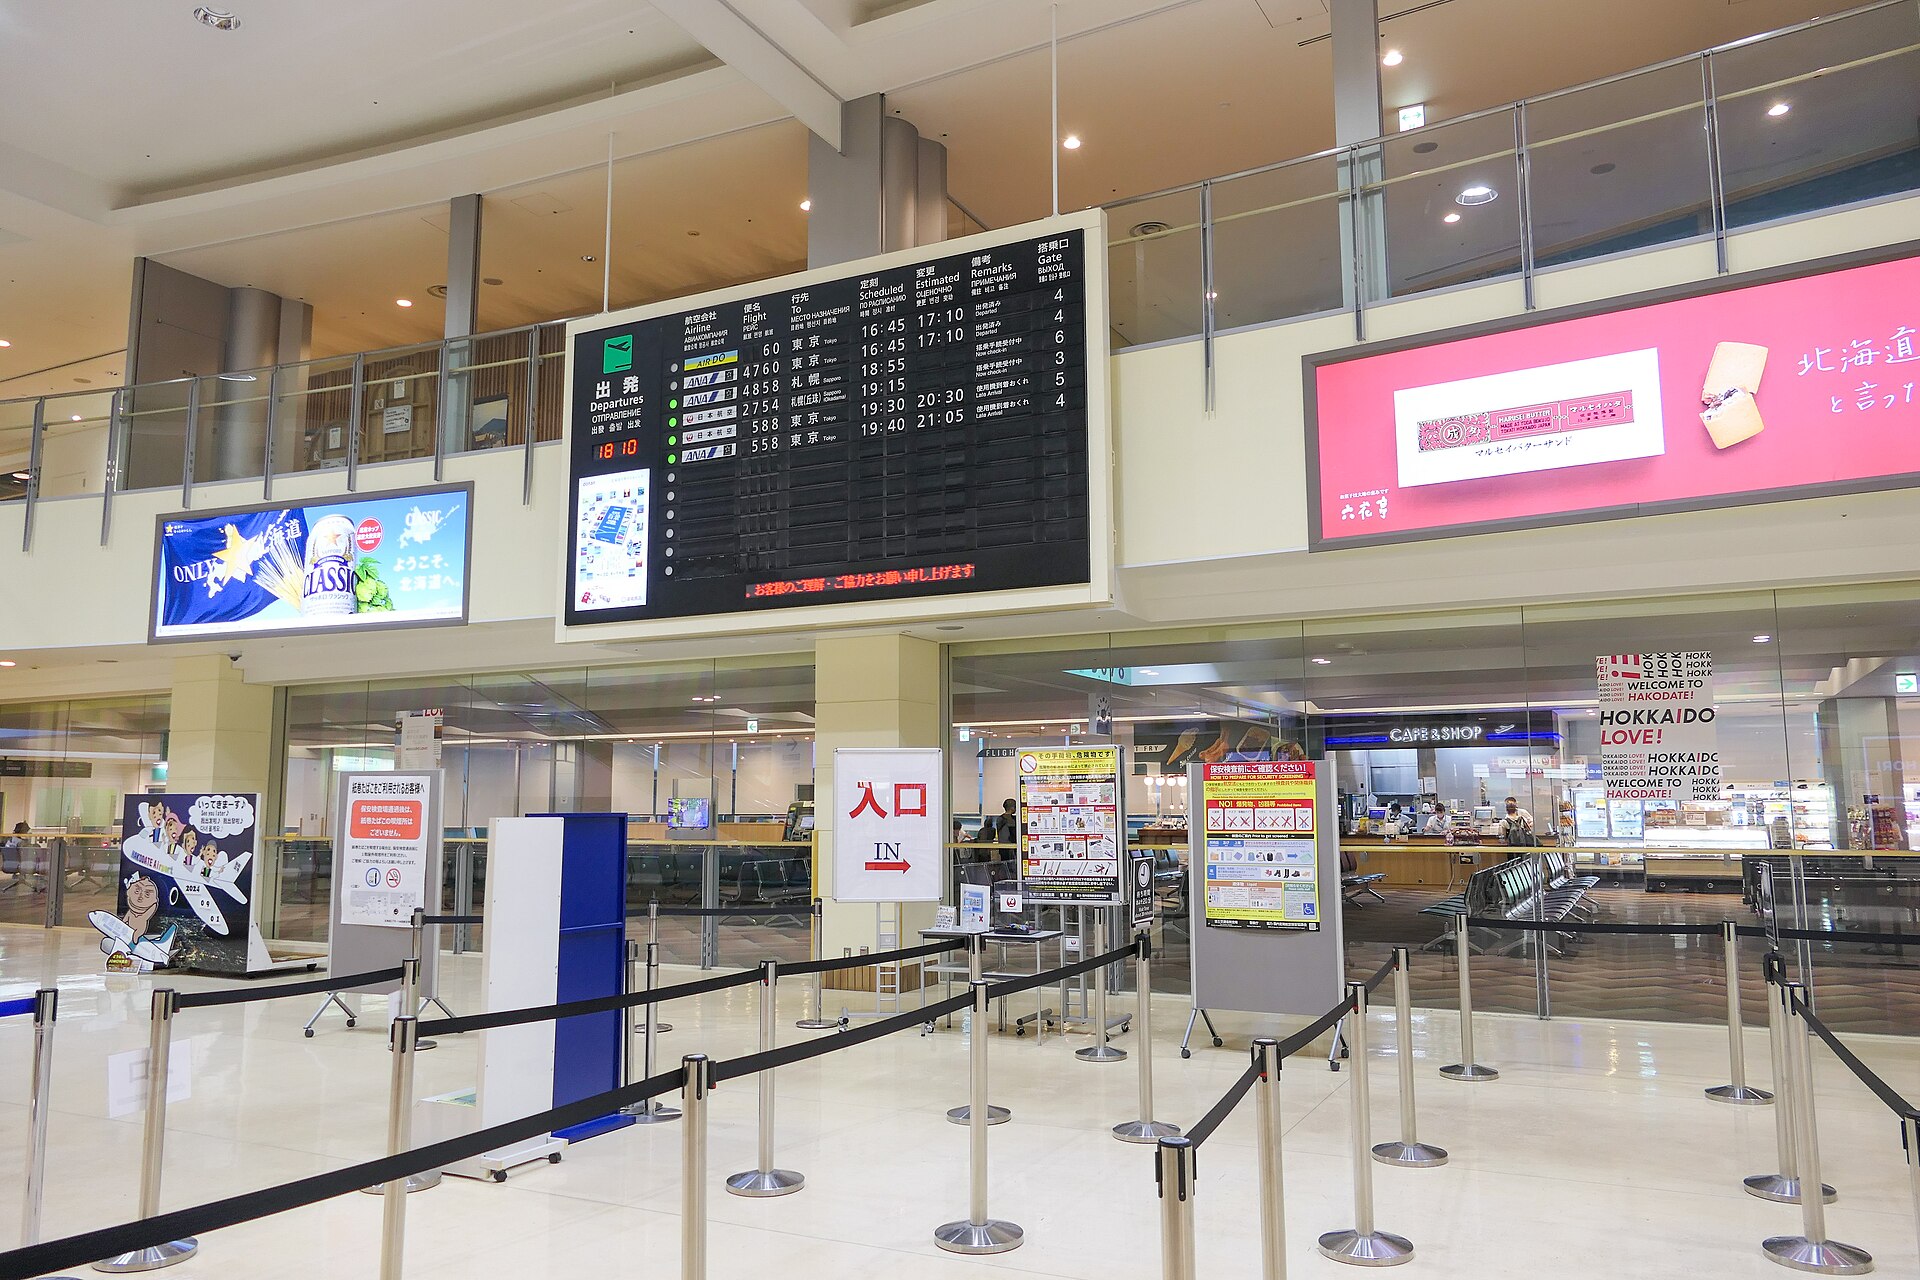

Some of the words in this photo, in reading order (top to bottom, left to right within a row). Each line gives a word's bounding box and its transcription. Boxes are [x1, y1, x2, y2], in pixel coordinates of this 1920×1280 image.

[1038, 238, 1069, 254] 搭乗口
[971, 253, 992, 267] 備考
[1037, 253, 1063, 265] Gate
[916, 265, 936, 278] 変更
[971, 262, 1013, 279] Remarks
[1037, 263, 1065, 275] ВЫХОД
[860, 277, 879, 290] 定刻
[915, 271, 960, 290] Estimated
[970, 272, 1017, 288] ПРИМЕЧАНИЯ
[791, 292, 810, 304] 行先
[859, 283, 904, 301] Scheduled
[915, 285, 953, 299] ОЦЕНОЧНО
[743, 302, 761, 314] 便名
[791, 305, 802, 315] To
[859, 301, 869, 310] ПО
[868, 294, 907, 308] РАСПИСАНИЮ
[684, 310, 717, 326] 航空会社
[743, 312, 767, 325] Flight
[790, 313, 811, 323] МЕСТО
[811, 305, 851, 319] НАЗНАЧЕНИЯ
[975, 307, 998, 317] Departed
[684, 323, 711, 336] Airline
[696, 356, 711, 368] AIR
[712, 352, 726, 364] DO
[762, 341, 780, 357] 60
[791, 334, 821, 351] 東京
[861, 318, 906, 338] 16:45
[917, 307, 964, 328] 17:10
[1054, 287, 1064, 302] 4
[743, 323, 759, 333] РЕЙС
[975, 328, 998, 337] Departed
[683, 329, 728, 344] АВИАКОМПАНИЯ
[686, 377, 709, 389] ANA
[742, 361, 780, 379] 4760
[791, 353, 821, 371] 東京
[861, 337, 906, 358] 16:45
[917, 327, 964, 349] 17:10
[1054, 308, 1064, 323] 4
[1797, 325, 1920, 376] 北海道
[686, 395, 709, 407] ANA
[742, 379, 780, 398] 4858
[791, 373, 820, 389] 札幌
[822, 375, 842, 384] Sapporo
[861, 357, 906, 378] 18:55
[1054, 329, 1065, 344] 6
[697, 408, 733, 421] 日本航空
[742, 398, 780, 417] 2754
[823, 388, 842, 397] Sapporo
[861, 377, 906, 398] 19:15
[1055, 351, 1065, 365] 3
[590, 395, 645, 413] Departures
[697, 427, 733, 440] 日本航空
[751, 417, 779, 434] 588
[790, 411, 820, 429] 東京
[822, 414, 837, 422] Tokyo
[861, 397, 906, 417] 19:30
[916, 388, 964, 409] 20:30
[1055, 371, 1065, 386] 5
[591, 407, 643, 424] ОТПРАВЛЕНИЕ
[1525, 409, 1551, 419] BUTTER
[685, 449, 708, 462] ANA
[751, 436, 779, 453] 558
[790, 431, 820, 447] 東京
[822, 434, 837, 442] Tokyo
[861, 417, 906, 437] 19:40
[916, 408, 964, 429] 21:05
[1055, 393, 1066, 408] 4
[599, 442, 615, 459] 18
[622, 438, 638, 456] 10
[1475, 435, 1573, 457] マルセイバターサンド
[1340, 495, 1388, 520] 六花亭
[173, 558, 218, 583] ONLY
[303, 566, 357, 599] CLASSIC
[1685, 651, 1712, 660] HOKK
[1686, 660, 1712, 669] HOKK
[1686, 669, 1713, 678] HOKK
[1627, 680, 1685, 691] WELCOME
[1687, 679, 1704, 688] TO
[1628, 690, 1694, 702] HAKODATE!
[1600, 707, 1716, 726] HOKKAIDO
[1389, 727, 1428, 743] CAFE
[1429, 728, 1441, 741] &
[1440, 726, 1482, 741] SHOP
[1600, 728, 1663, 745] LOVE!
[1209, 763, 1307, 774] 保安検査前にご確認ください!
[1606, 779, 1663, 788] WELCOME
[1666, 778, 1682, 788] TO
[848, 781, 927, 820] 入口
[1606, 789, 1672, 799] HAKODATE!
[1218, 800, 1233, 808] NO!
[873, 842, 901, 860] IN
